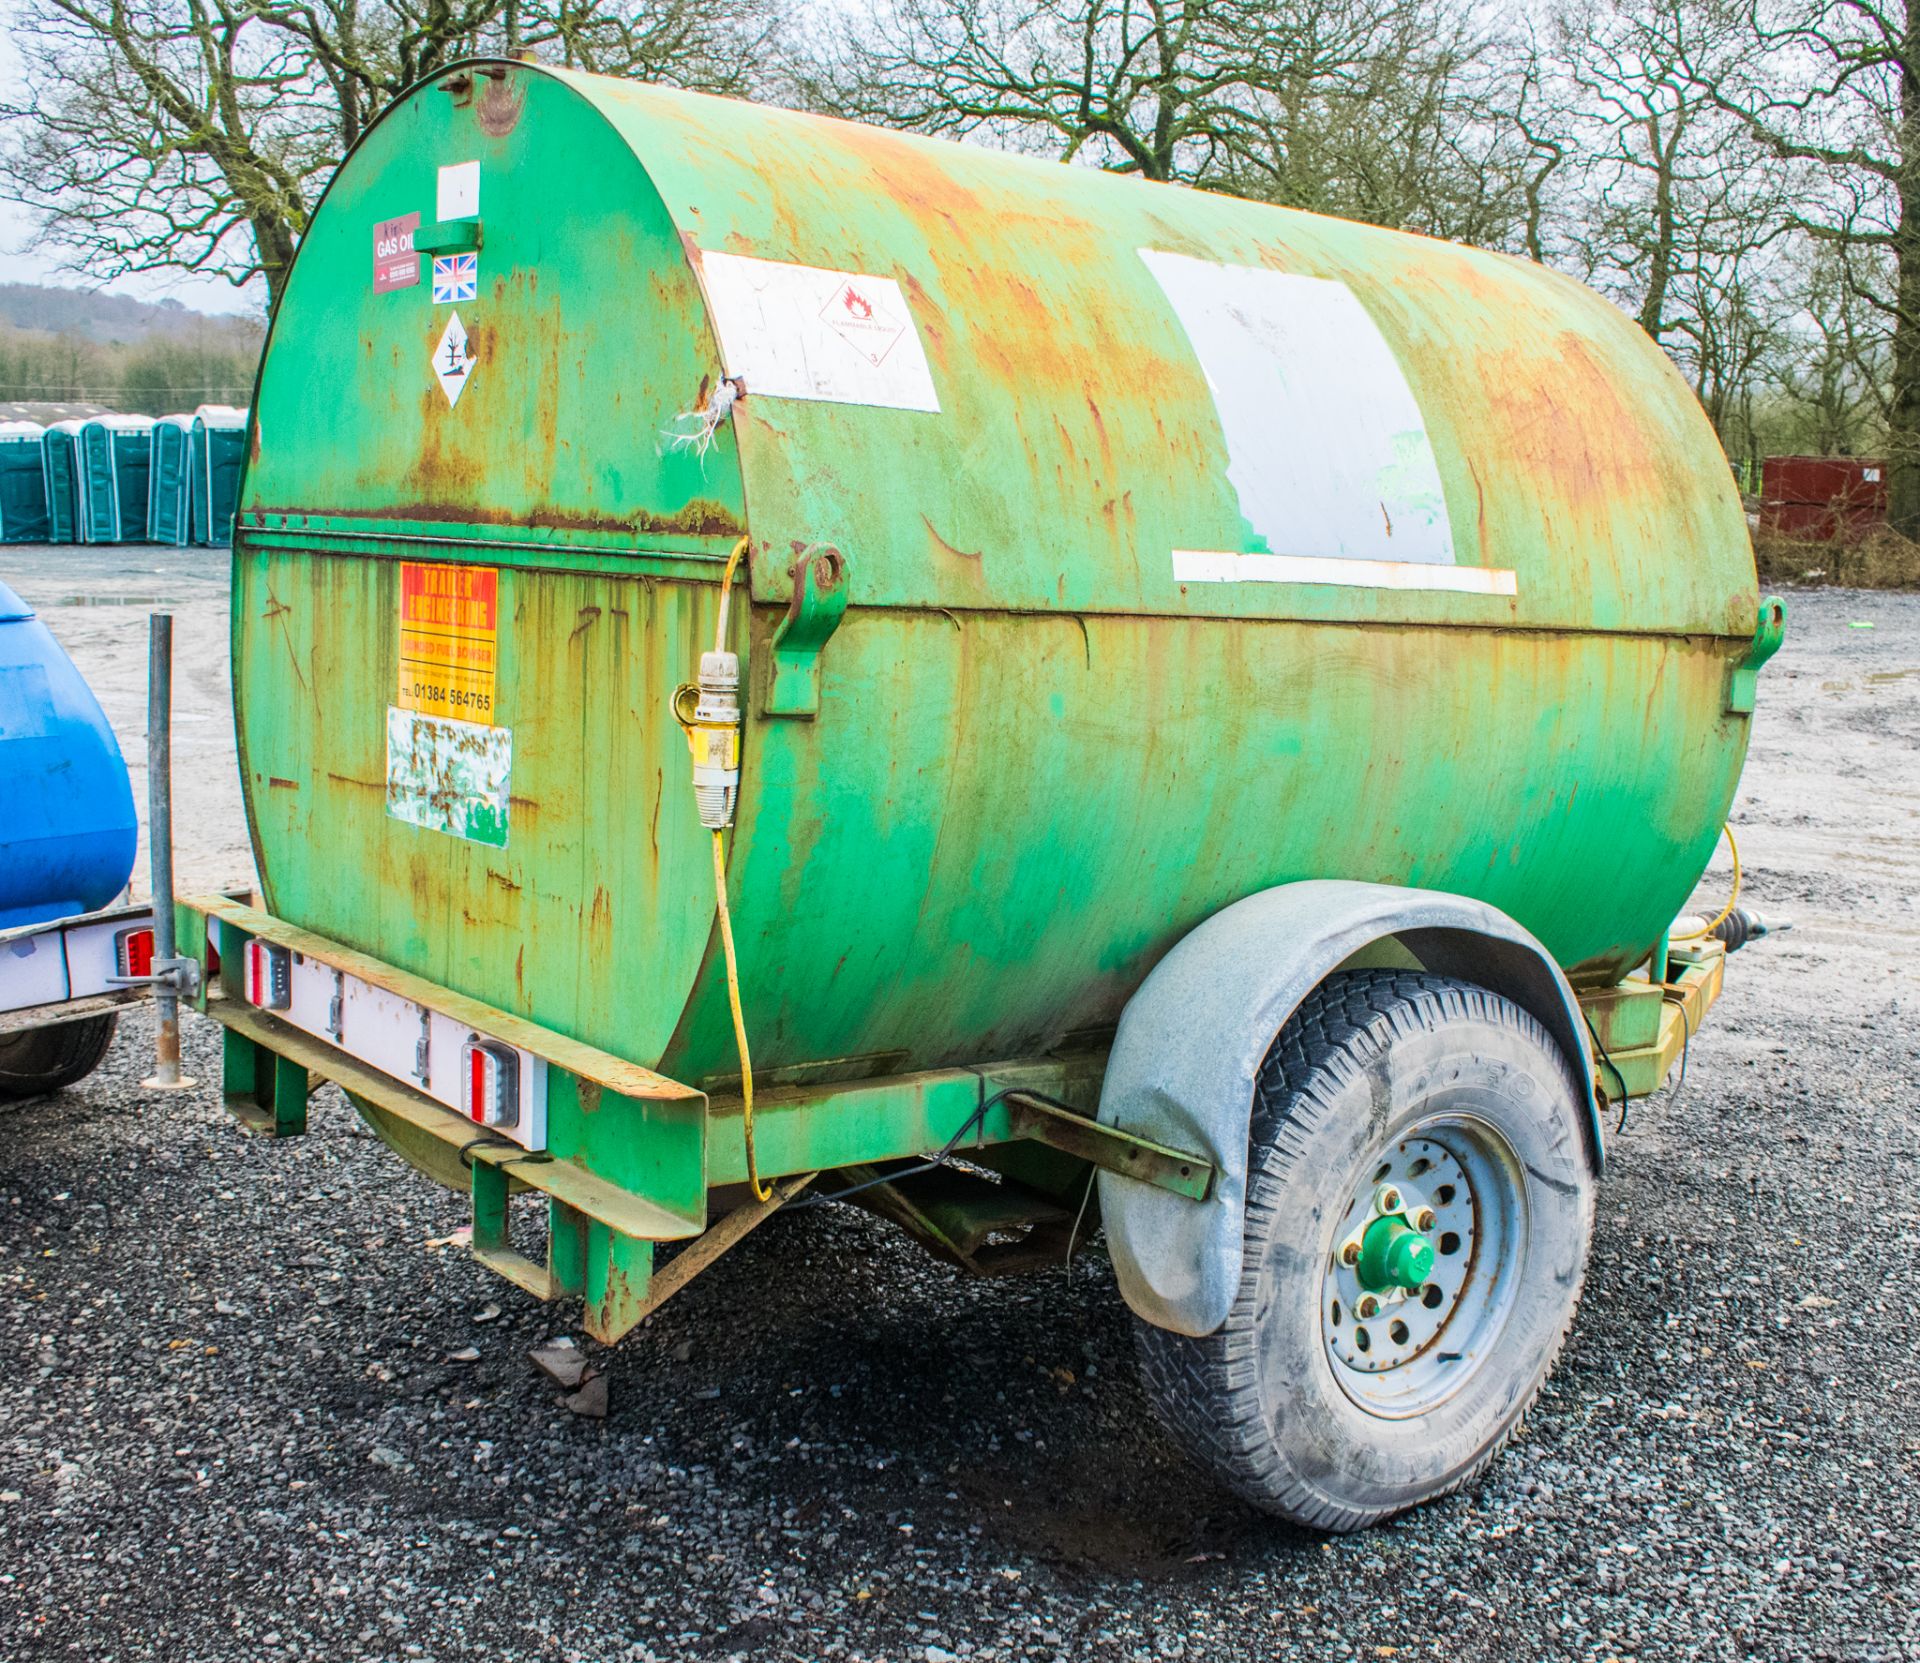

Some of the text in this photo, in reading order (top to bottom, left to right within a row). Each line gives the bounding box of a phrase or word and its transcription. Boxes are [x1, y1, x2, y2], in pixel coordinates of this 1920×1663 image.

[377, 237, 397, 258] GAS
[424, 569, 472, 598] TRAILER
[409, 594, 488, 627] ENGINEERING
[414, 682, 445, 702] 01384
[449, 689, 490, 711] 564765
